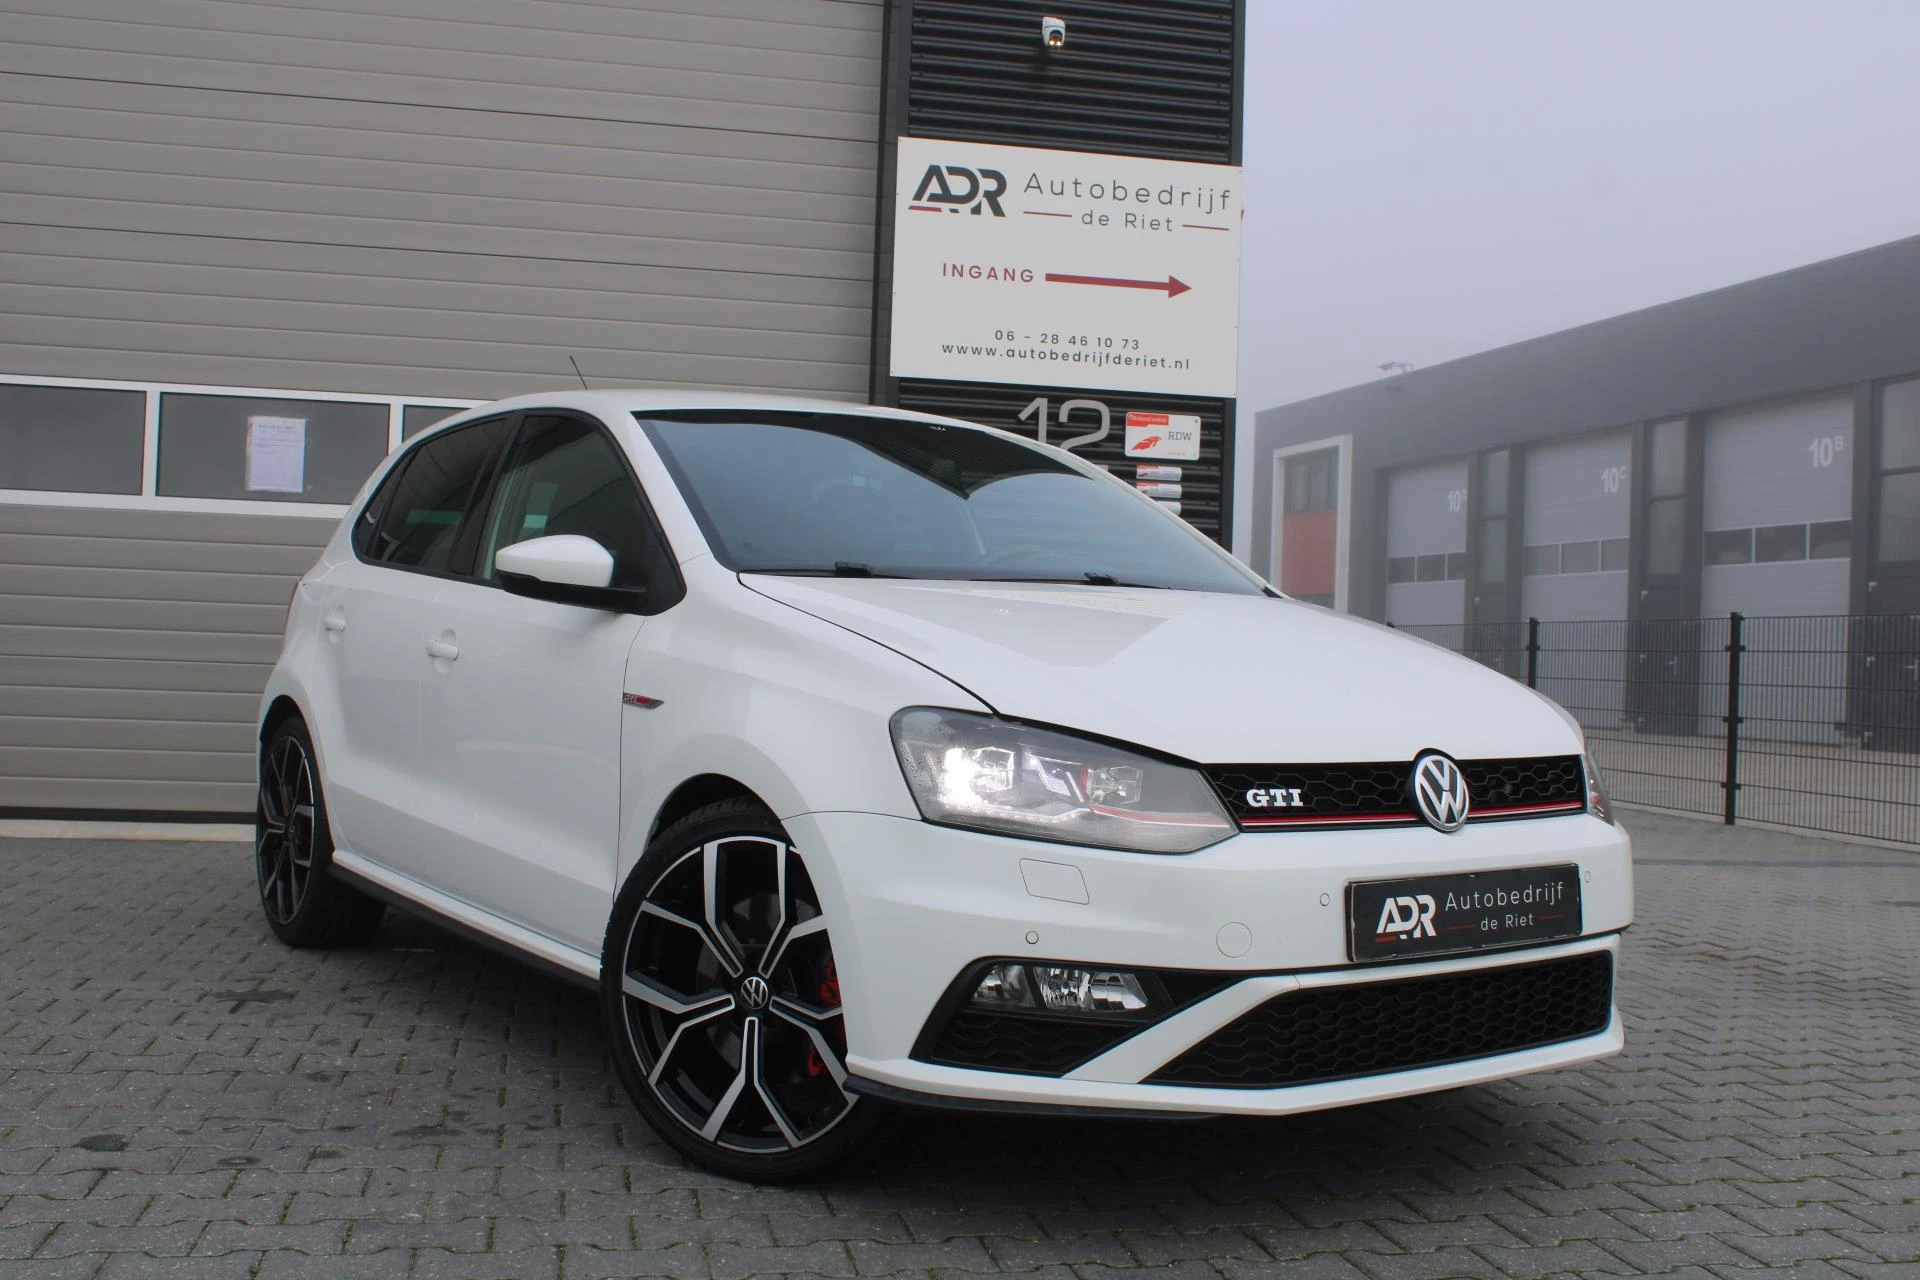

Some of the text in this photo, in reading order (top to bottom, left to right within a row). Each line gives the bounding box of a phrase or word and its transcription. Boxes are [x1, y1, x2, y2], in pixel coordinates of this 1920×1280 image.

[908, 164, 1231, 218] ADR Autobedrijf
[1081, 210, 1173, 232] de Riet
[942, 262, 1035, 283] INGANG
[995, 329, 1015, 342] 06
[1040, 333, 1059, 345] 28
[1068, 335, 1088, 347] 46
[1097, 337, 1113, 349] 10
[1121, 339, 1140, 350] 73
[941, 343, 1190, 370] wwww.autobedrijfderiet.nl
[1168, 431, 1192, 441] RDW
[1246, 788, 1303, 808] GTI
[1376, 881, 1564, 939] ADR Autobedrijf
[1480, 913, 1534, 931] de Riet
